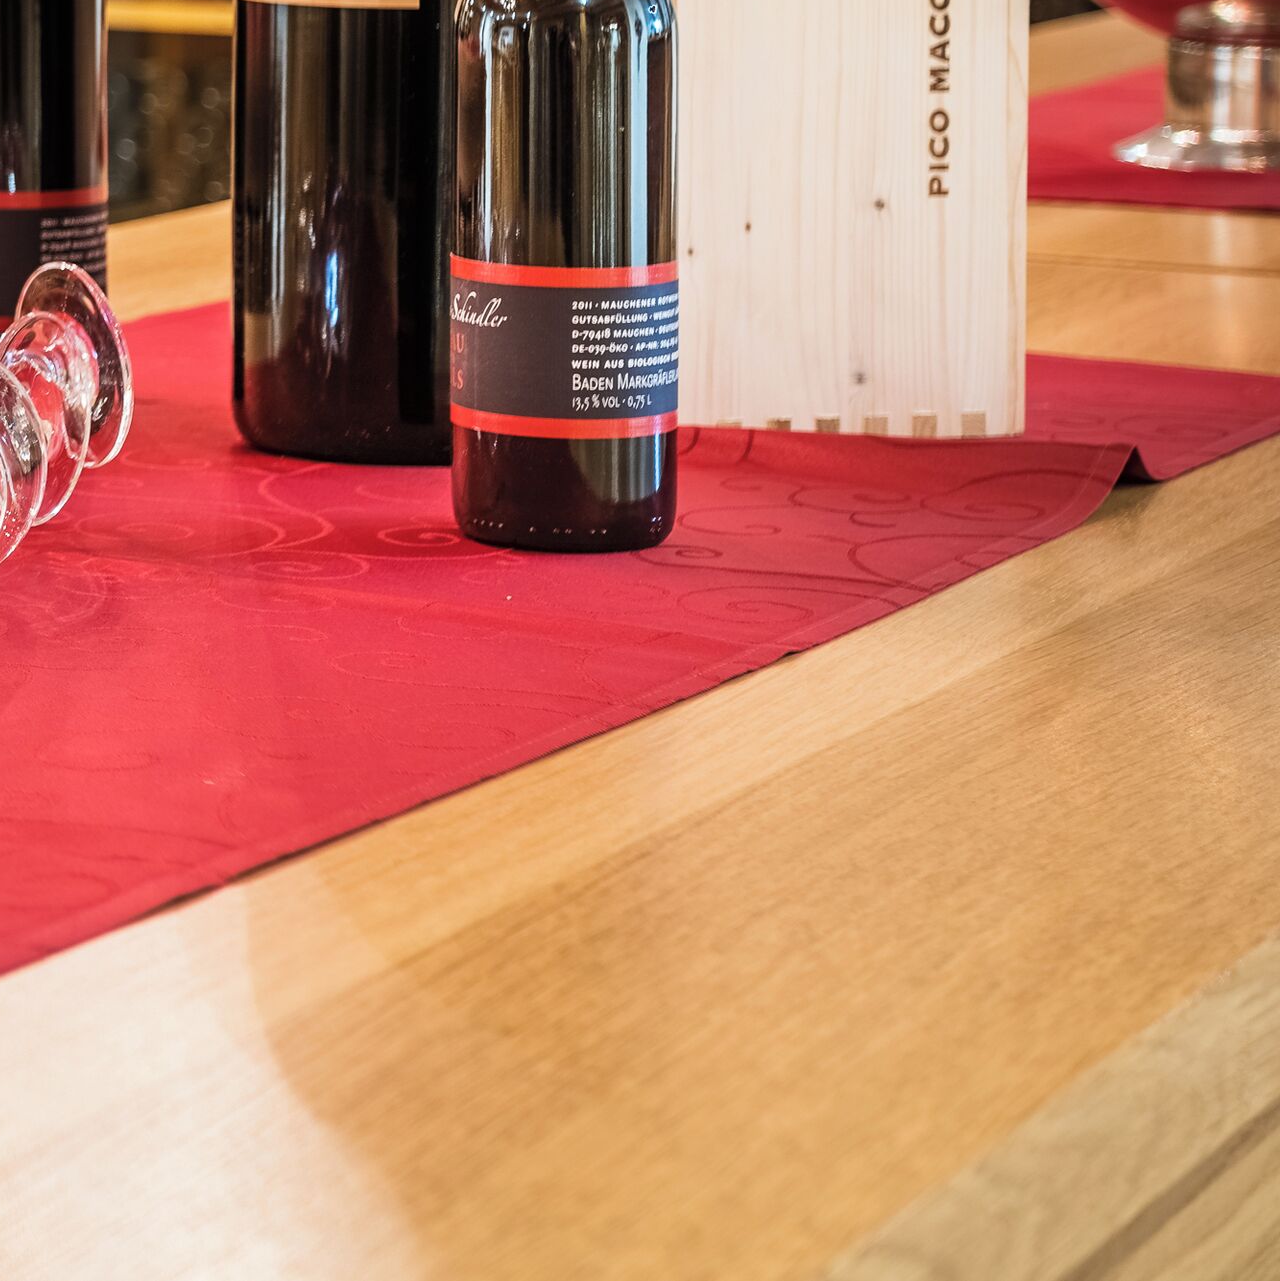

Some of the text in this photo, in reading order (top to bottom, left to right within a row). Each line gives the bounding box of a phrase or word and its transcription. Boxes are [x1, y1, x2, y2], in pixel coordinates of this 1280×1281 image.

[928, 109, 951, 198] PICO
[451, 290, 508, 328] Schindler
[571, 300, 593, 311] 2011
[600, 297, 656, 311] MAUCHENER
[571, 312, 648, 325] GUTSABFÜLLUNG
[571, 327, 611, 341] D-79418
[613, 326, 654, 338] MAUCHEN
[571, 359, 600, 369] WEIN
[603, 358, 625, 369] AUS
[572, 393, 653, 412] 13,5 % VOL 0,75 L
